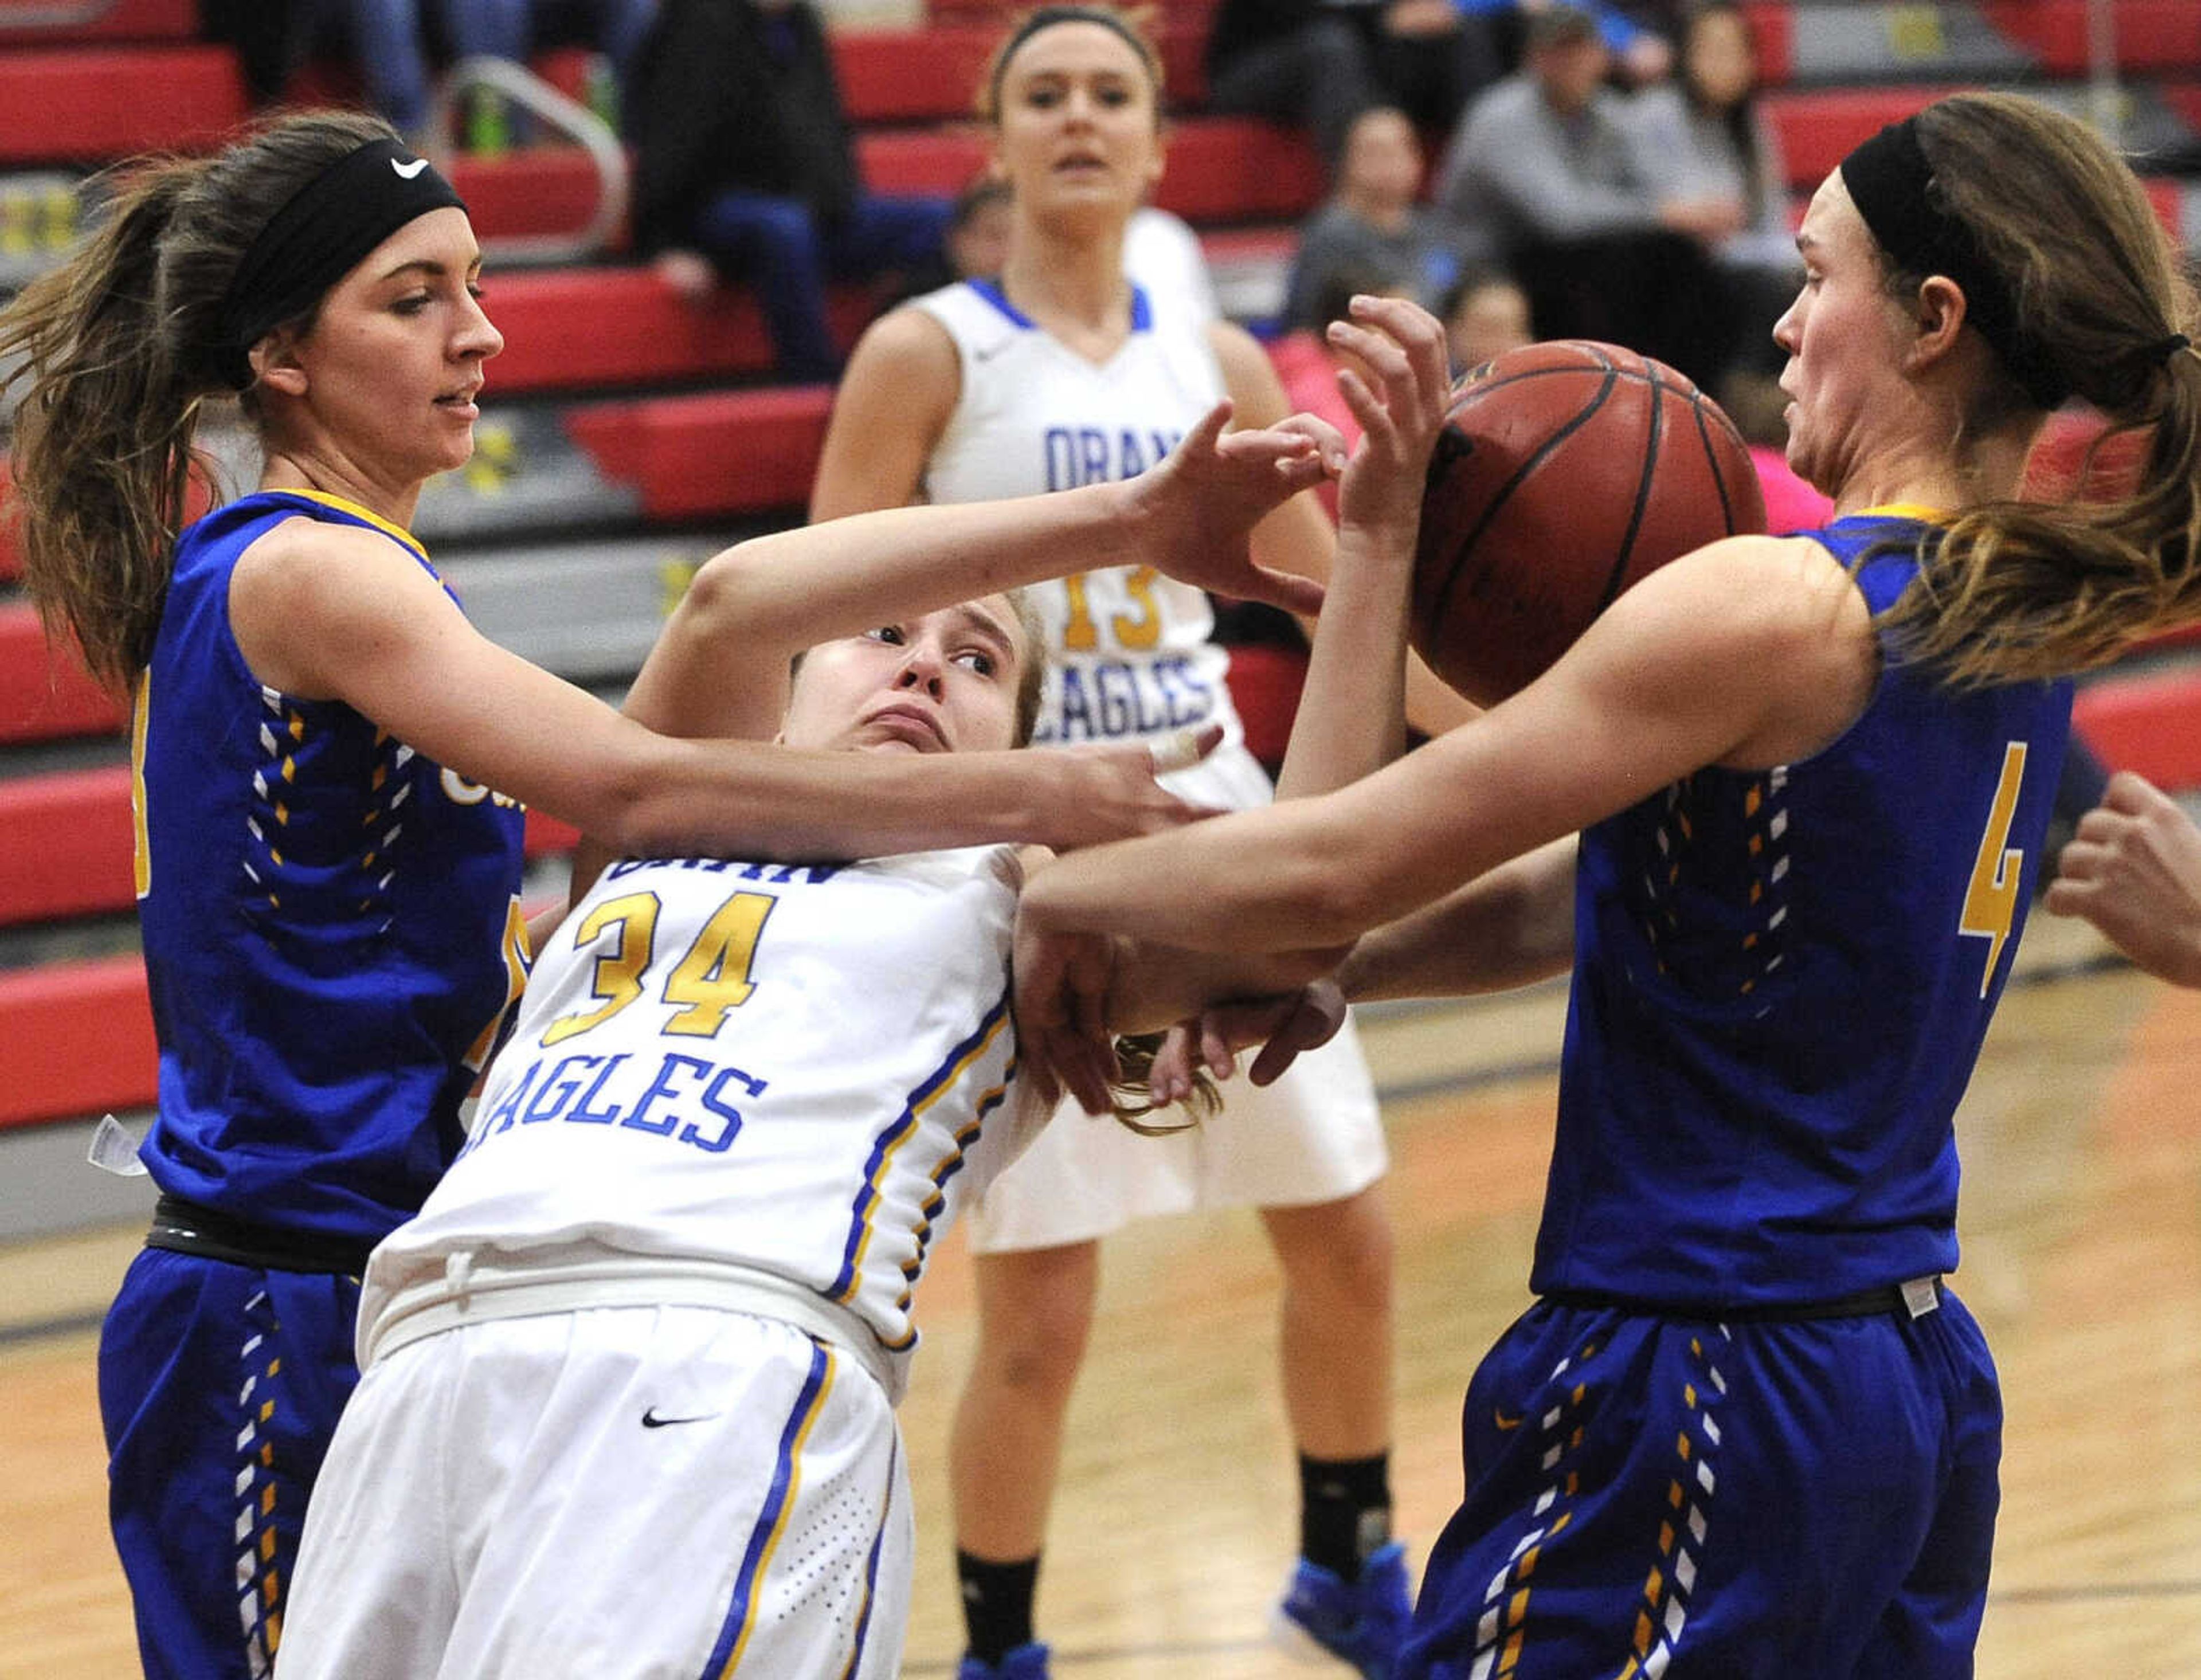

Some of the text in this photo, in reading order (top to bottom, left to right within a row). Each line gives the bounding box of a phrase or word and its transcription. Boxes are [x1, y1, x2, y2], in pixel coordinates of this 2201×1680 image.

[1033, 656, 1213, 739] AGLES
[1958, 741, 2028, 1000] 4
[539, 890, 778, 1048] 34
[457, 1053, 769, 1165] AGLES
